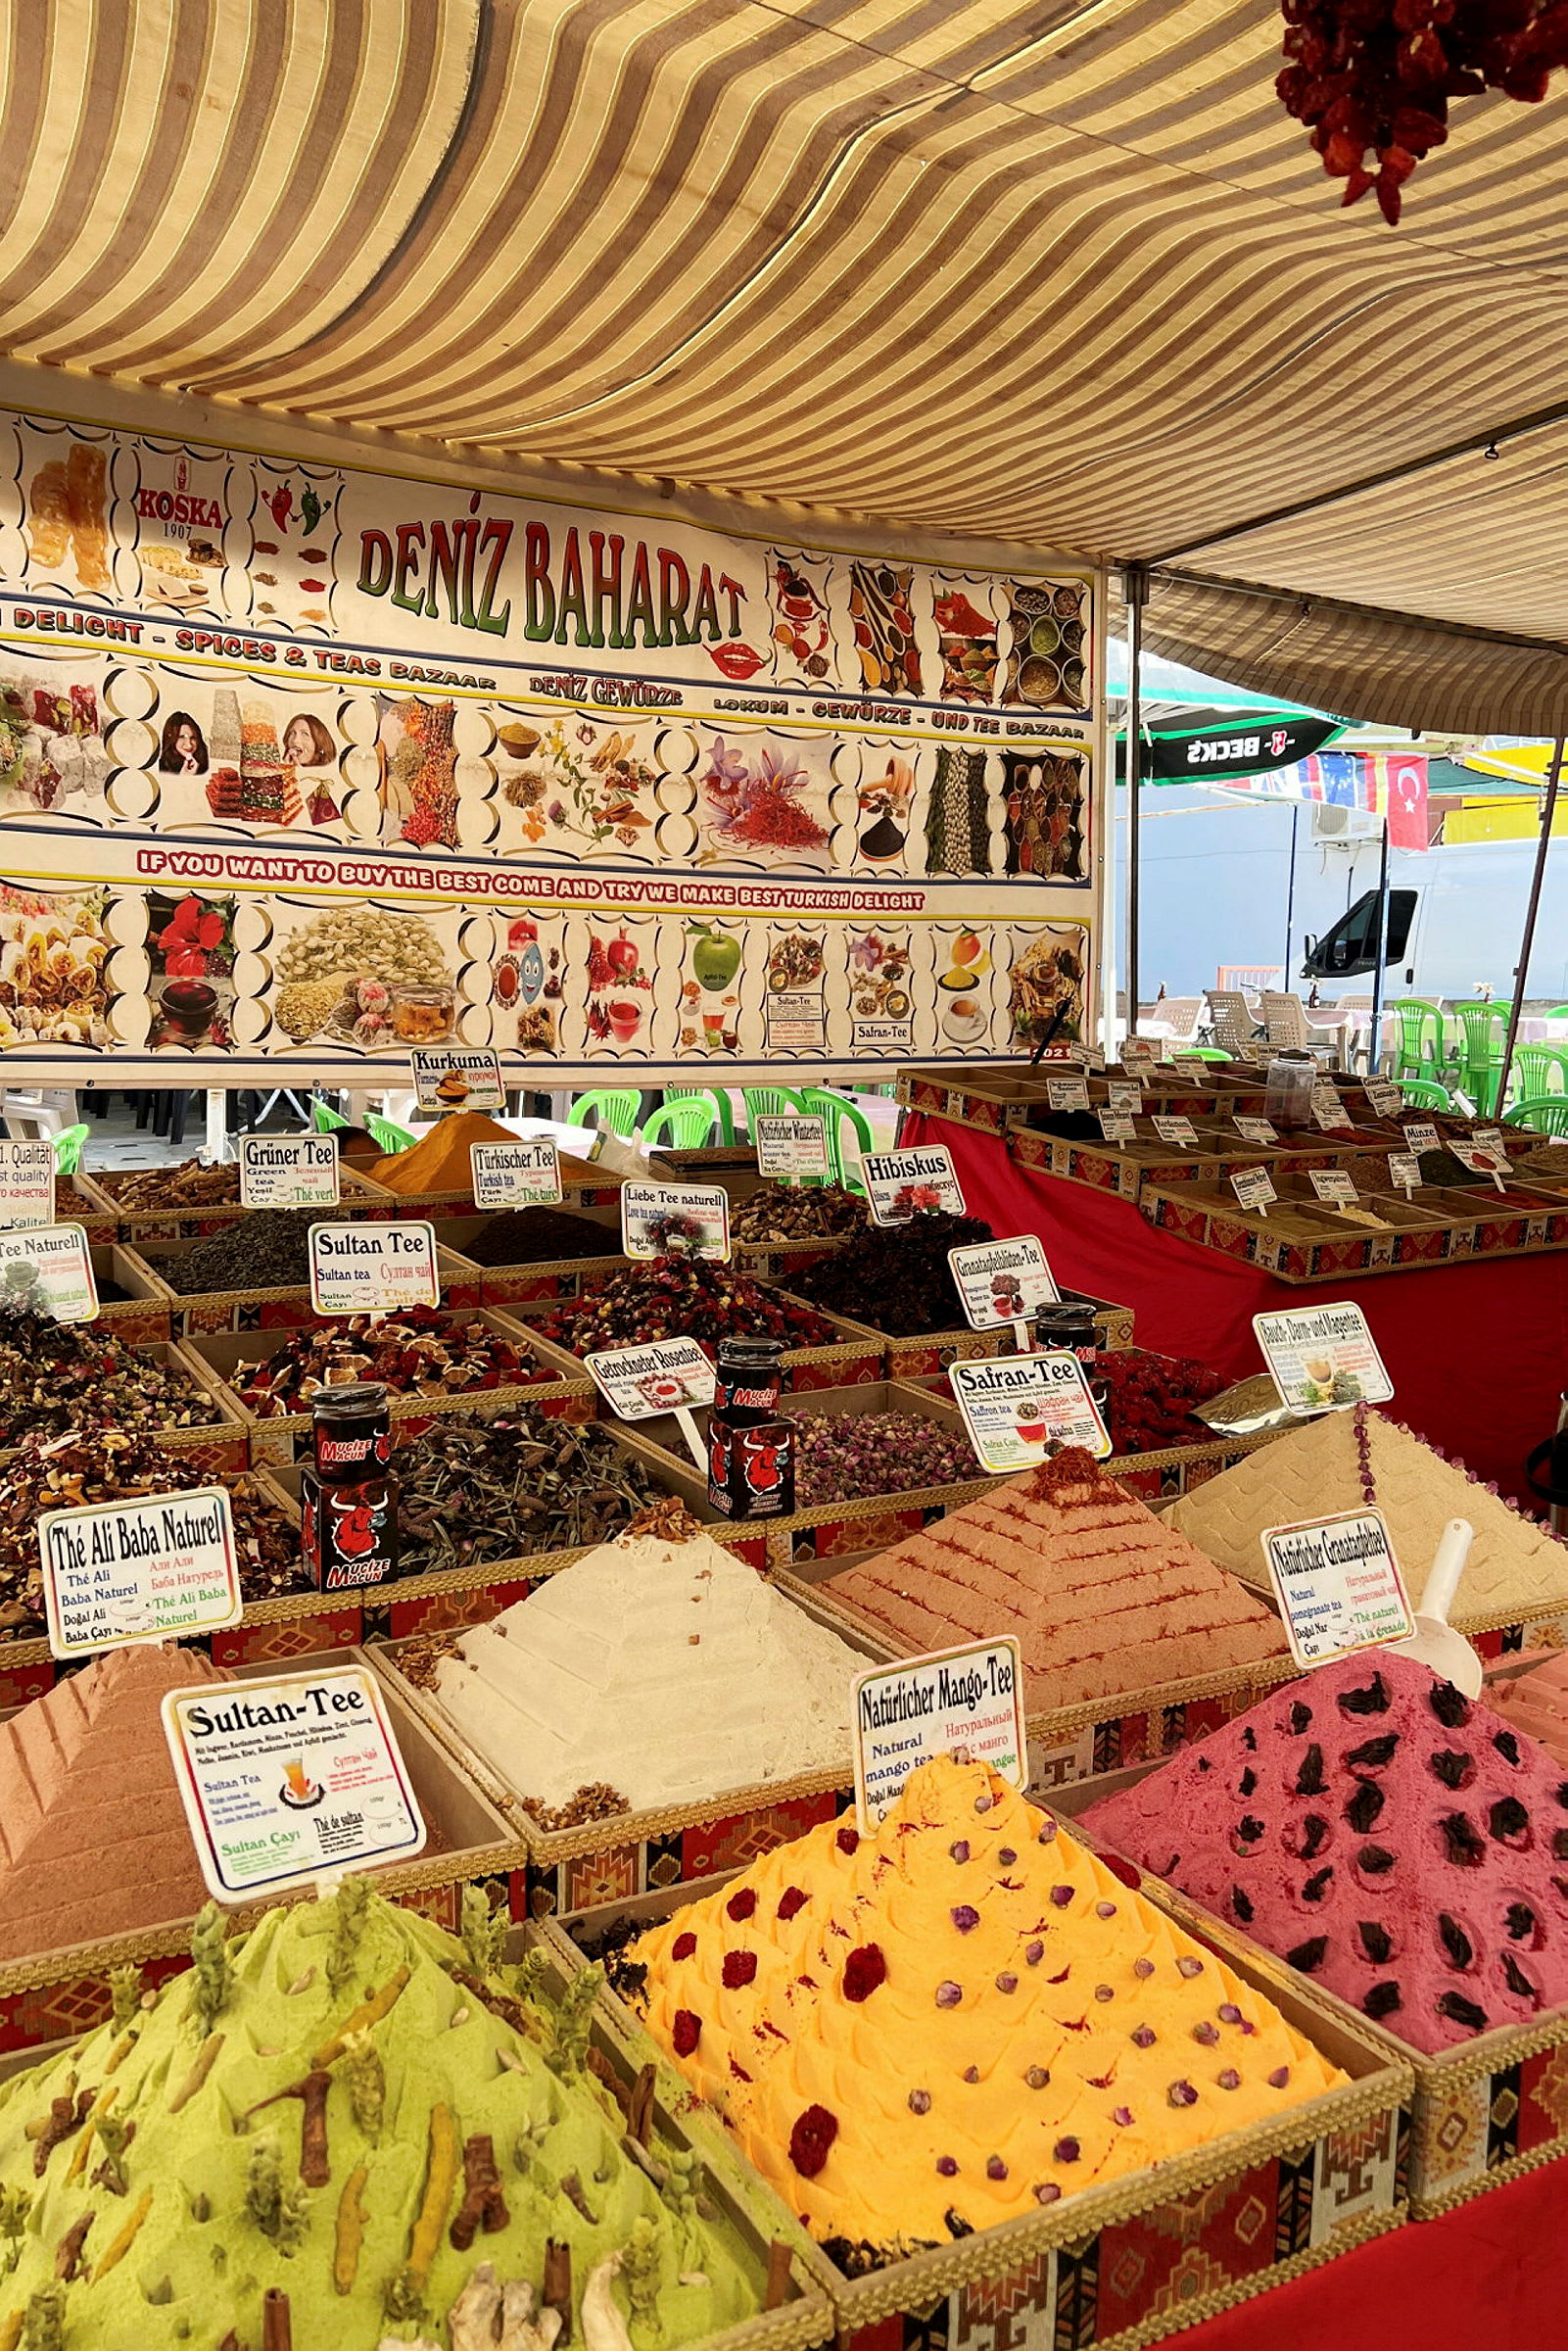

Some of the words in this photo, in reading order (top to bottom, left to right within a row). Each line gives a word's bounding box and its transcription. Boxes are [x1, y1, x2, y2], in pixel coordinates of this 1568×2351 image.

[138, 488, 223, 530] KOSKA
[164, 523, 192, 540] 1907
[524, 522, 749, 648] BAHARAT
[14, 608, 144, 644] DELIGHT
[175, 629, 276, 661] SPICES
[284, 647, 307, 667] &
[313, 650, 382, 676] TEAS
[390, 661, 497, 691] BAZAAR
[591, 676, 684, 707] GEWÜRZE
[714, 698, 788, 715] LOKUM
[812, 701, 912, 725] GEWÜRZE
[931, 710, 970, 731] UND
[973, 716, 1000, 734] TEE
[1006, 720, 1085, 740] BAZAAR
[137, 850, 166, 874] IF
[167, 851, 223, 877] YOU
[226, 856, 299, 881] WANT
[300, 860, 335, 883] TO
[338, 863, 393, 887] BUY
[393, 866, 433, 889] THE
[436, 871, 490, 893] BEST
[492, 874, 555, 896] COME
[556, 879, 602, 899] AND
[604, 882, 644, 902] TRY
[646, 883, 678, 902] WE
[680, 884, 735, 904] MAKE
[736, 887, 783, 907] BEST
[784, 888, 851, 910] TURKISH
[852, 890, 926, 911] DELIGHT
[858, 1026, 908, 1038] Safran-Tee
[416, 1051, 495, 1070] Kurkuma
[1406, 1128, 1436, 1138] Minze
[12, 1145, 50, 1169] Qualität
[247, 1141, 300, 1166] Grüner
[304, 1140, 333, 1165] Tee
[477, 1147, 532, 1171] Türkischer
[534, 1146, 553, 1167] Tee
[12, 1171, 49, 1184] quality
[866, 1153, 947, 1181] Hibiskus
[478, 1174, 502, 1187] Turkish
[503, 1173, 515, 1186] tea
[314, 1187, 333, 1201] vert
[628, 1187, 656, 1202] Liebe
[658, 1190, 679, 1204] Tee
[682, 1195, 722, 1206] naturell
[11, 1218, 47, 1228] Kalite
[24, 1234, 80, 1255] Naturell
[318, 1233, 383, 1255] Sultan
[388, 1232, 424, 1253] Tee
[317, 1268, 352, 1280] Sultan
[355, 1270, 371, 1280] tea
[594, 1354, 658, 1379] Getrockneter
[652, 1345, 703, 1368] Rosentee
[959, 1360, 1075, 1391] Safran-Tee
[53, 1525, 87, 1570] Thé
[92, 1519, 116, 1565] Ali
[117, 1514, 161, 1559] Baba
[162, 1502, 221, 1552] Naturel
[67, 1573, 90, 1588] Thé
[93, 1570, 111, 1584] Ali
[62, 1591, 92, 1607] Baba
[95, 1583, 139, 1601] Naturel
[152, 1596, 178, 1610] Thé
[180, 1592, 197, 1606] Ali
[198, 1587, 227, 1603] Baba
[1290, 1585, 1315, 1603] Natural
[1331, 1600, 1343, 1611] tea
[64, 1610, 91, 1627] Doğal
[92, 1607, 107, 1620] Ali
[155, 1609, 198, 1628] Naturel
[1372, 1603, 1400, 1621] naturel
[65, 1629, 89, 1644] Baba
[91, 1626, 113, 1642] Çayı
[1315, 1621, 1328, 1636] Nar
[861, 1676, 934, 1733] Natürlicher
[938, 1655, 1013, 1711] Mango-Tee
[187, 1688, 364, 1738] Sultan-Tee
[944, 1708, 1013, 1739] Натуральный
[872, 1732, 923, 1759] Natural
[978, 1736, 1009, 1751] манго
[866, 1760, 910, 1783] mango
[913, 1753, 933, 1769] tea
[204, 1779, 238, 1793] Sultan
[240, 1774, 261, 1785] Tea
[221, 1839, 267, 1857] Sultan
[269, 1829, 302, 1847] Çayı
